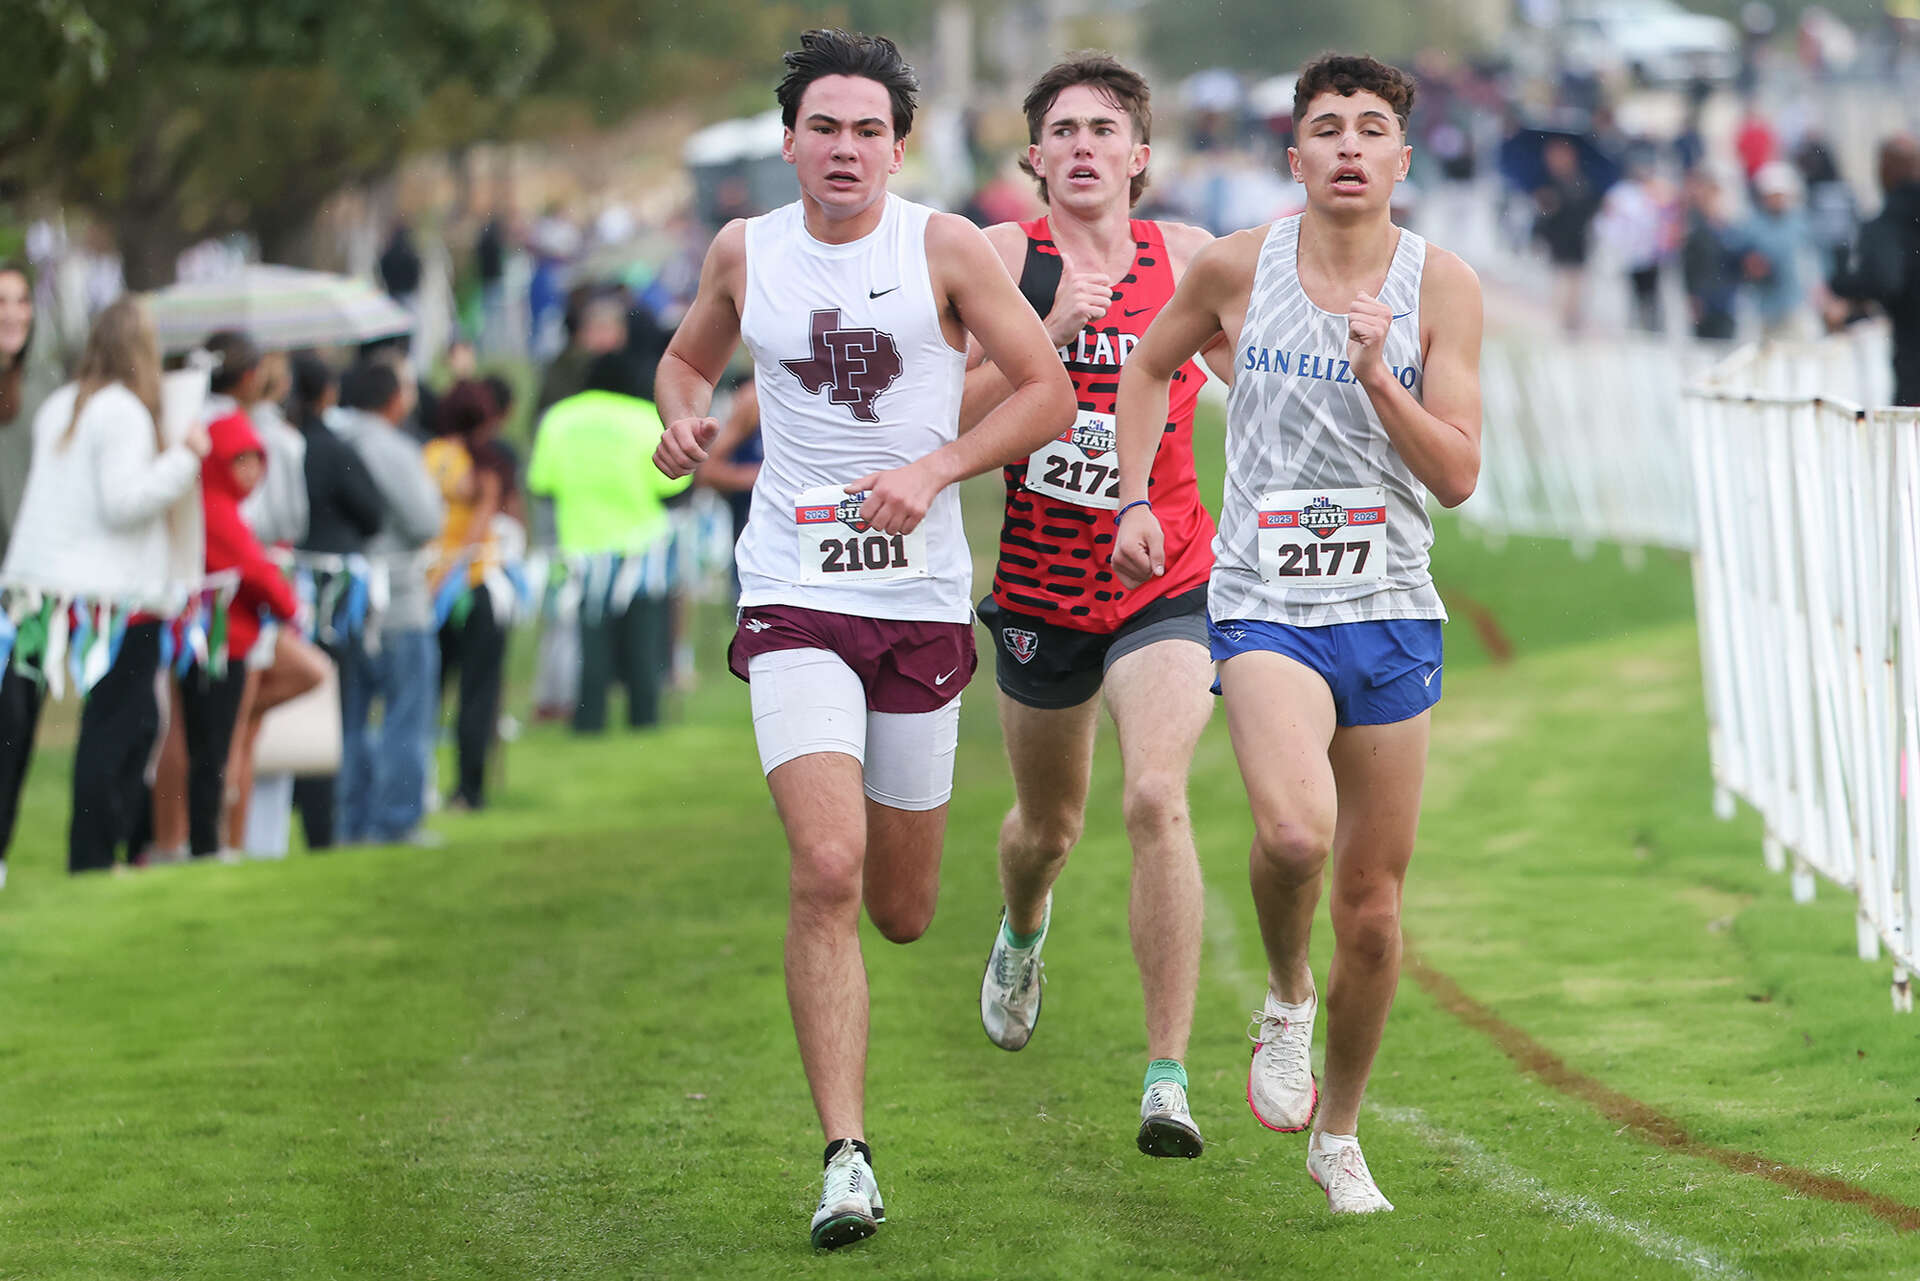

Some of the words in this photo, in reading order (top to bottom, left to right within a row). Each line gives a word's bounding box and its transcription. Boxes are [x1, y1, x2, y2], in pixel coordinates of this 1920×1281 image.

[1245, 346, 1291, 375] SAN
[1072, 432, 1116, 449] STATE
[1043, 455, 1120, 499] 2172
[805, 510, 830, 519] 2025
[1268, 515, 1292, 524] 2025
[1300, 512, 1347, 525] STATE
[1354, 512, 1378, 521] 2025
[820, 535, 908, 573] 2101
[1278, 541, 1371, 577] 2177
